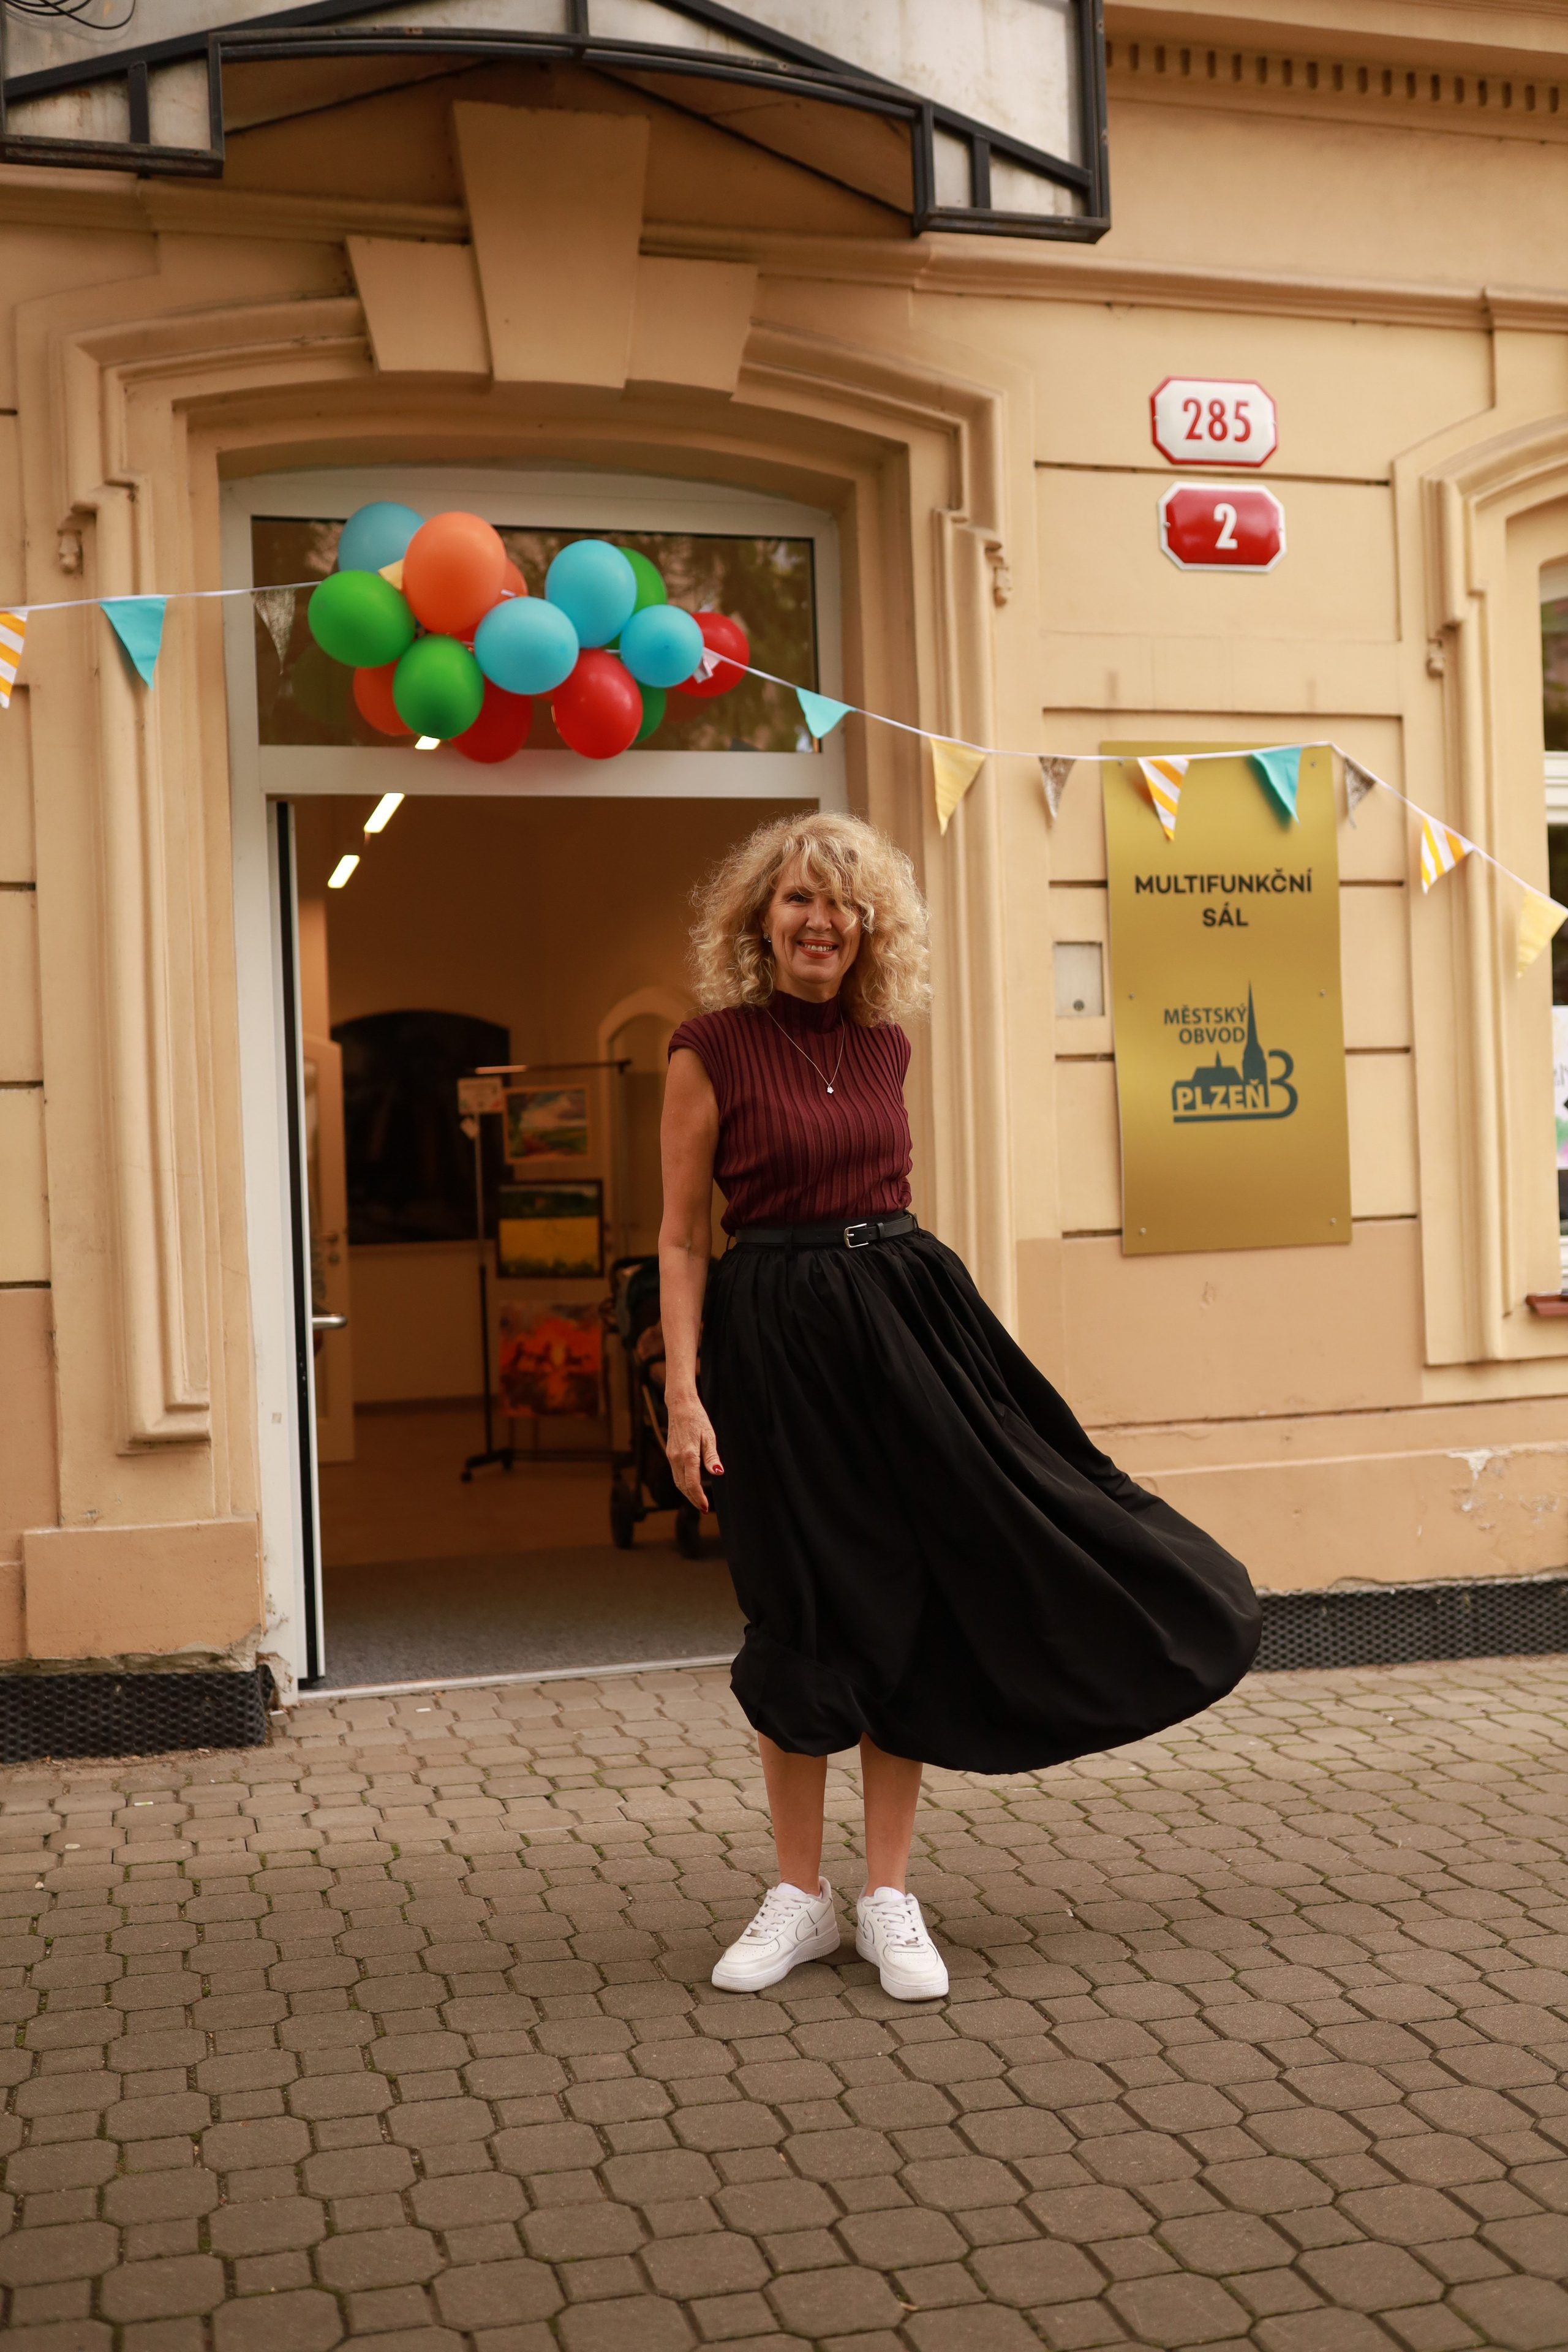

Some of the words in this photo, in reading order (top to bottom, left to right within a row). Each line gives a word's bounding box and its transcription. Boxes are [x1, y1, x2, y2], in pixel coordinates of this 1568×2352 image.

[1183, 398, 1251, 442] 285
[1213, 502, 1238, 549] 2
[1135, 867, 1312, 894] MULTIFUNKČNÍ
[1203, 902, 1248, 927] SÁL
[1164, 1003, 1246, 1025] MĚSTSKÝ
[1179, 1027, 1245, 1044] OBVOD
[1176, 1078, 1264, 1112] PLZEŇ
[1268, 1049, 1298, 1119] 3
